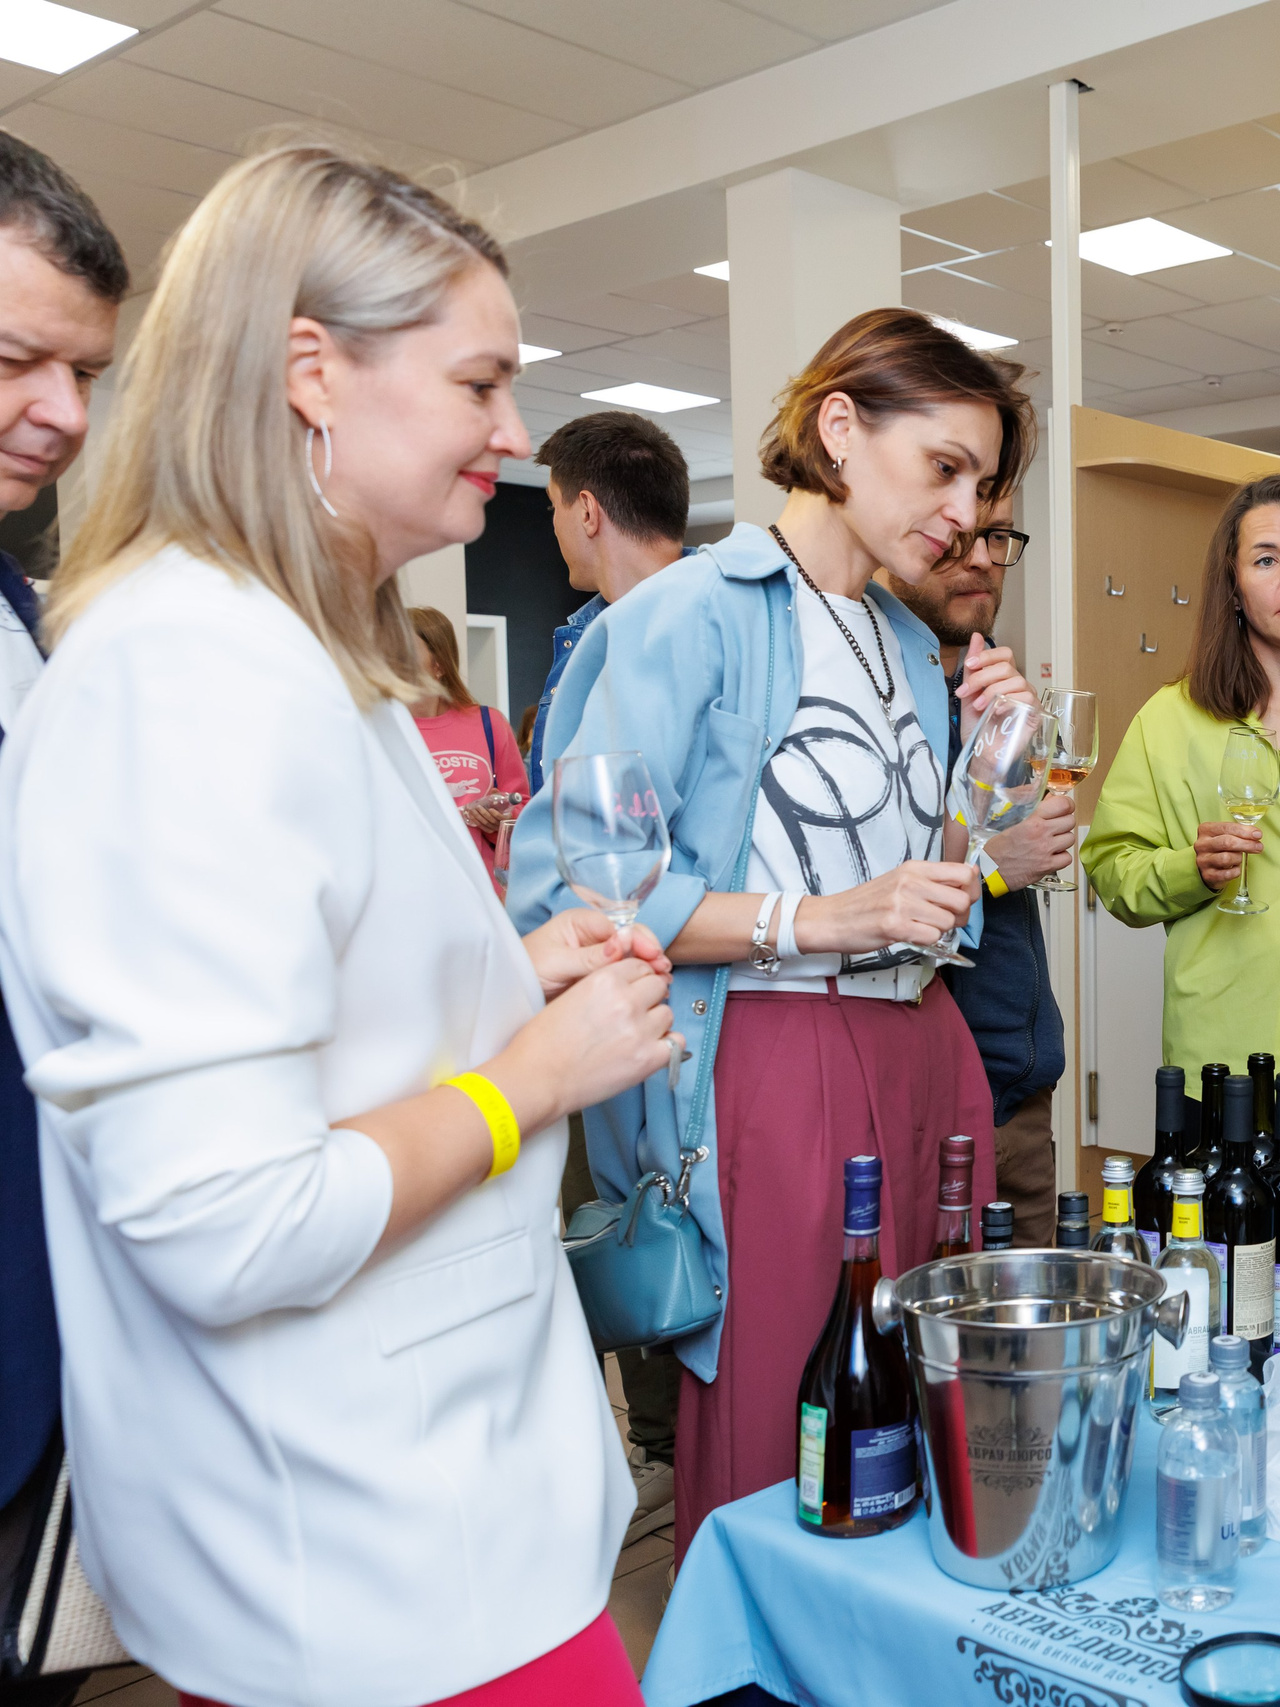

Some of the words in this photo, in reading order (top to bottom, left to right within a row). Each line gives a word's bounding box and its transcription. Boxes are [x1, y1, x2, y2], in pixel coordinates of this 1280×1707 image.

[978, 1600, 1181, 1684] АБРАУ-ДЮРСО
[983, 1621, 1042, 1651] РУССКИЙ
[1042, 1647, 1104, 1672] ВИННЫЙ
[1104, 1669, 1138, 1685] ДОМ
[1081, 1614, 1123, 1637] 1870
